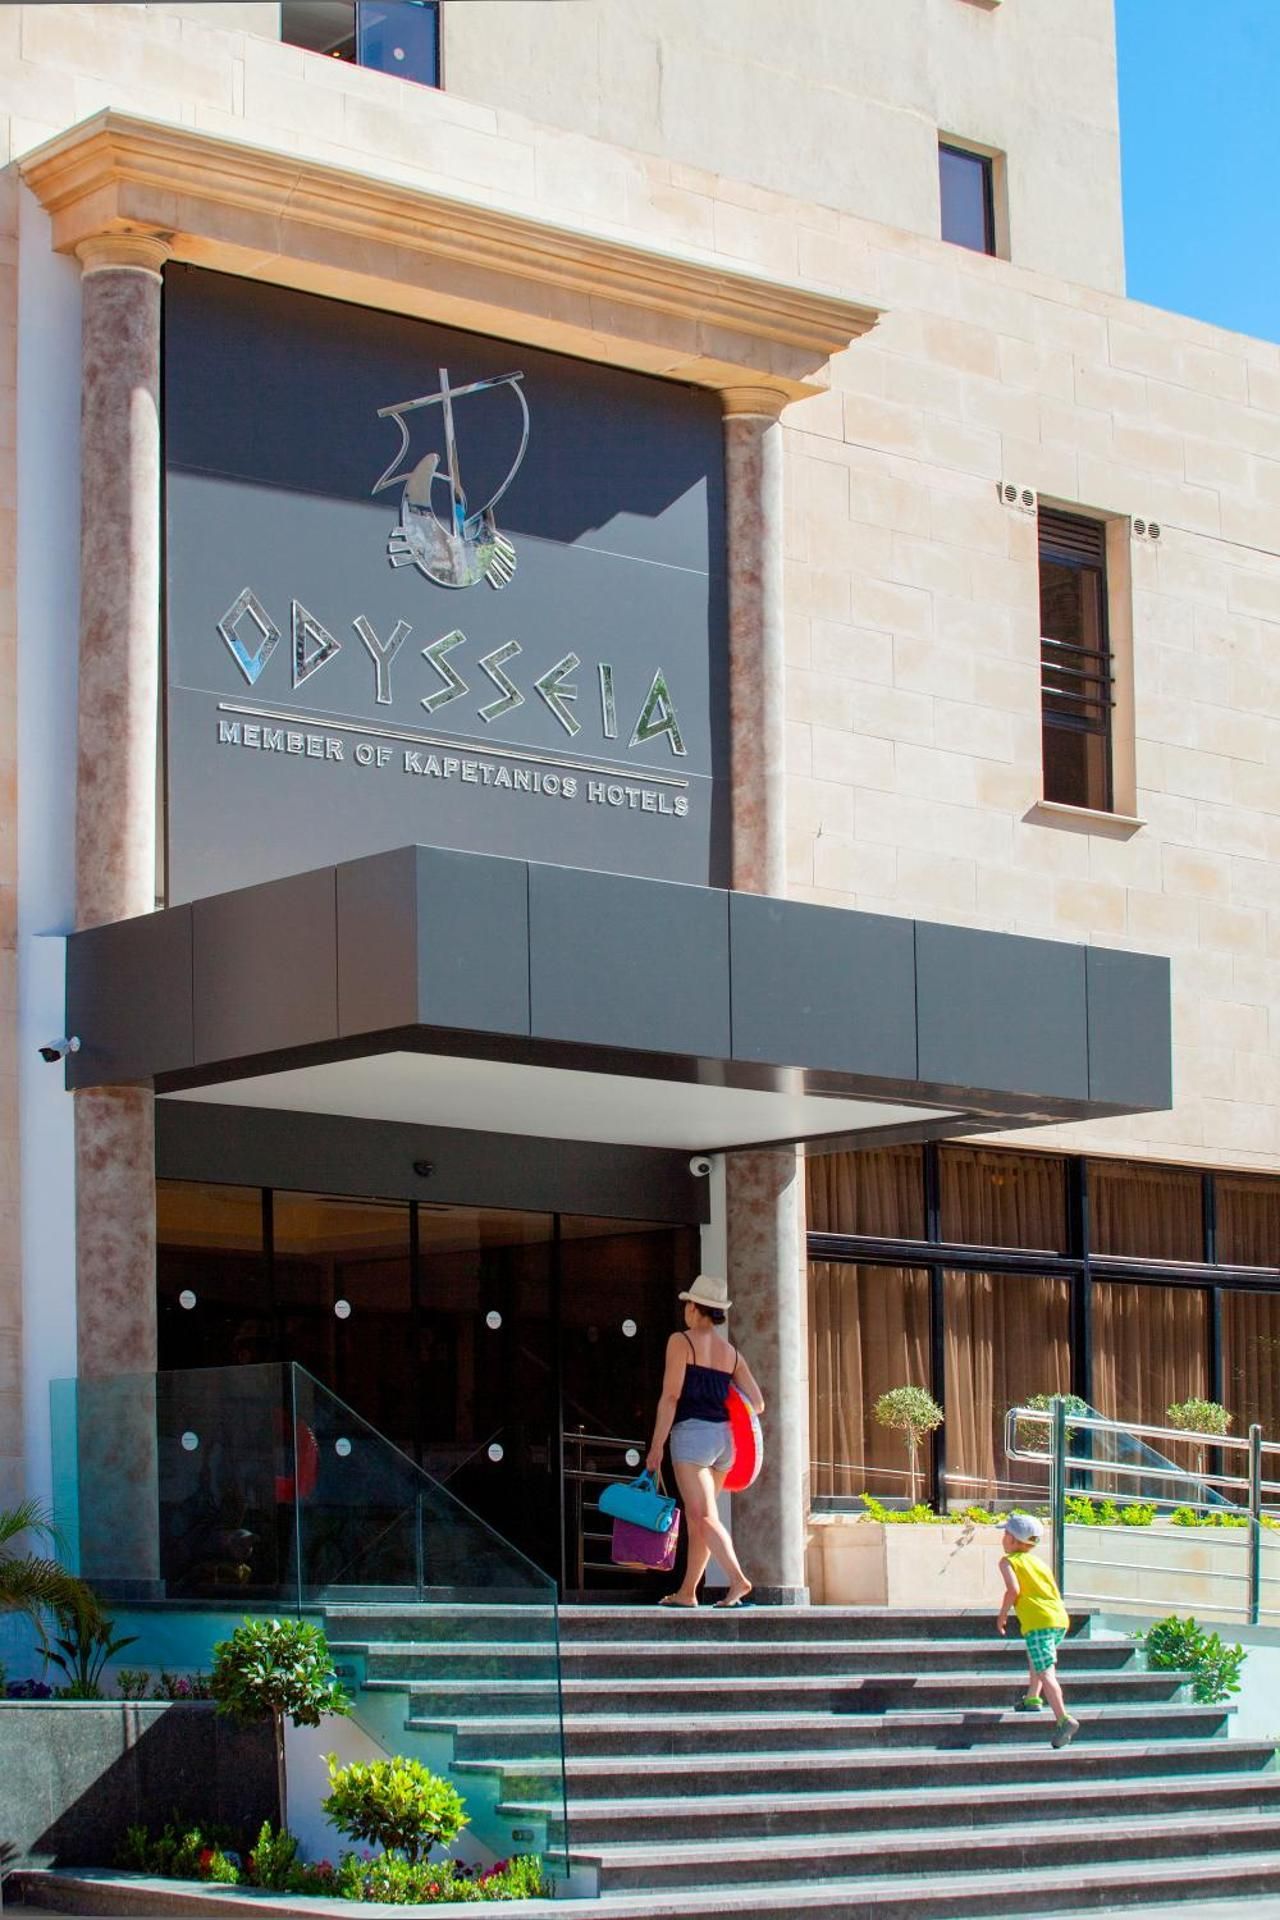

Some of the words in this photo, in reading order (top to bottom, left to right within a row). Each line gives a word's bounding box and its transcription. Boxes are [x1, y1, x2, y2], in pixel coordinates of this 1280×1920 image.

[218, 587, 688, 756] ODYSSEIA
[218, 720, 343, 761] MEMBER
[354, 743, 393, 768] OF
[404, 750, 577, 799] KAPETANIOS
[587, 780, 689, 816] HOTELS
